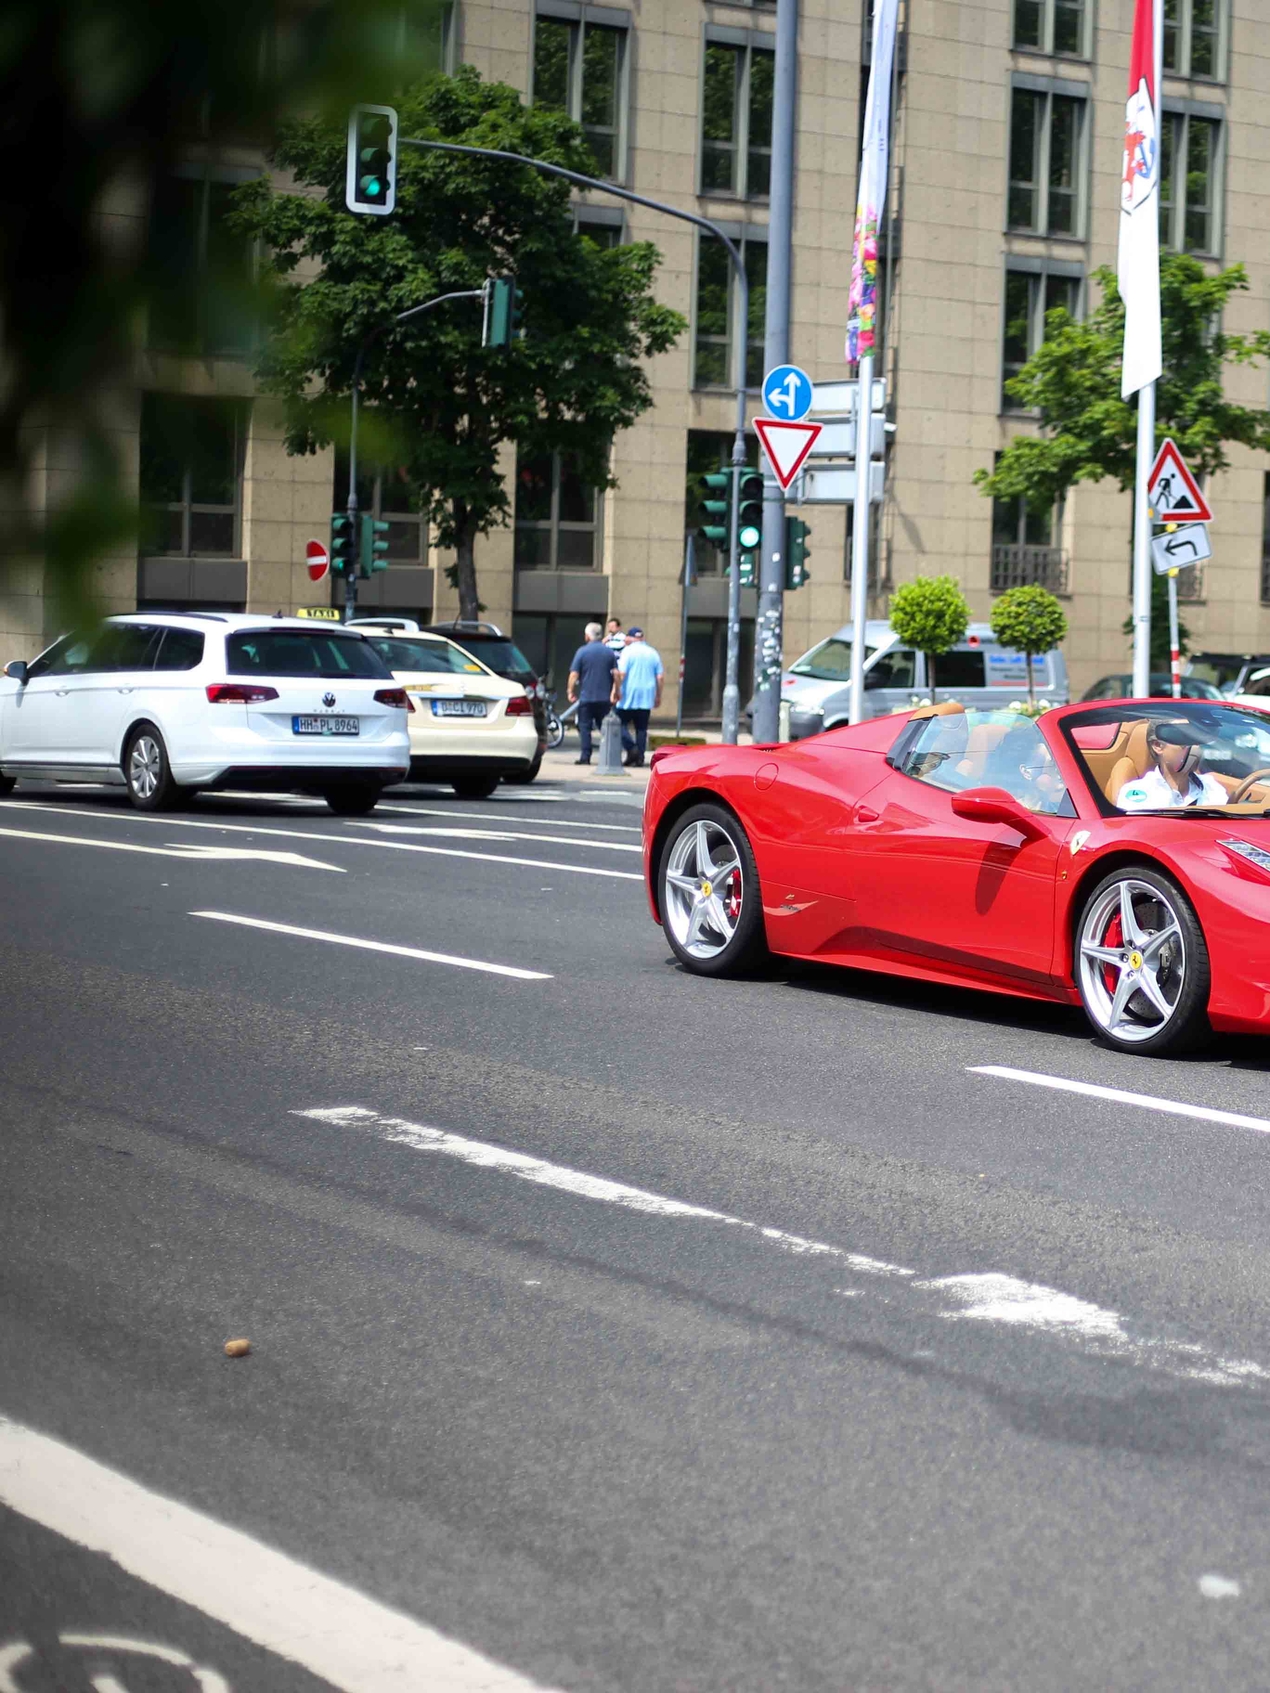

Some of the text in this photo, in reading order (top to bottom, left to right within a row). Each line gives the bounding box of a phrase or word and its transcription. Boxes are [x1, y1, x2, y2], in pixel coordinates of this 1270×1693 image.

[300, 718, 358, 732] HH PL 8964
